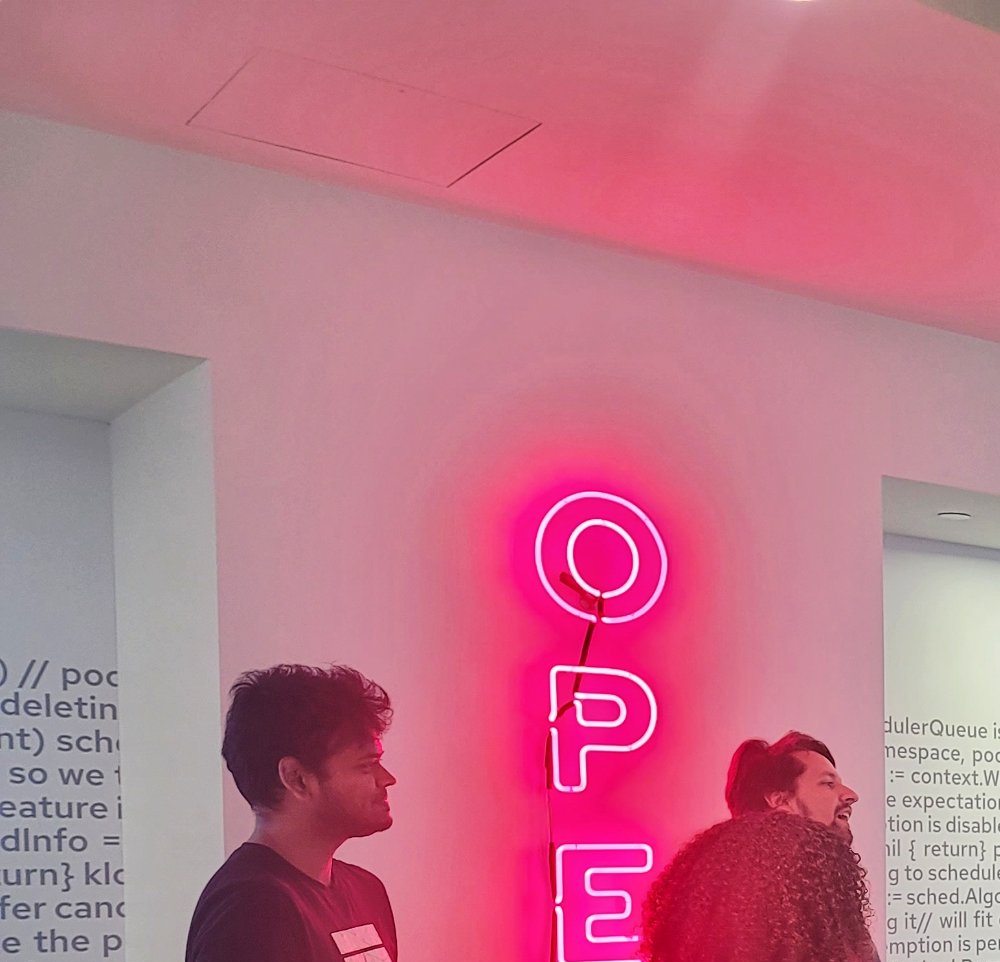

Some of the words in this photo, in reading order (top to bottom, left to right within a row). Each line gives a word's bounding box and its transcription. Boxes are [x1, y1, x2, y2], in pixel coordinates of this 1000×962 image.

[0, 691, 117, 720] deletin
[57, 729, 120, 753] sch
[9, 767, 48, 784] so
[58, 768, 104, 786] we
[0, 796, 108, 820] eature
[885, 814, 923, 833] tion
[928, 815, 941, 833] is
[924, 839, 987, 862] return}
[0, 862, 75, 892] urn}
[904, 865, 923, 881] to
[939, 911, 967, 928] will
[973, 910, 994, 928] fit
[33, 929, 90, 953] the
[886, 935, 952, 958] mption
[958, 934, 972, 952] is
